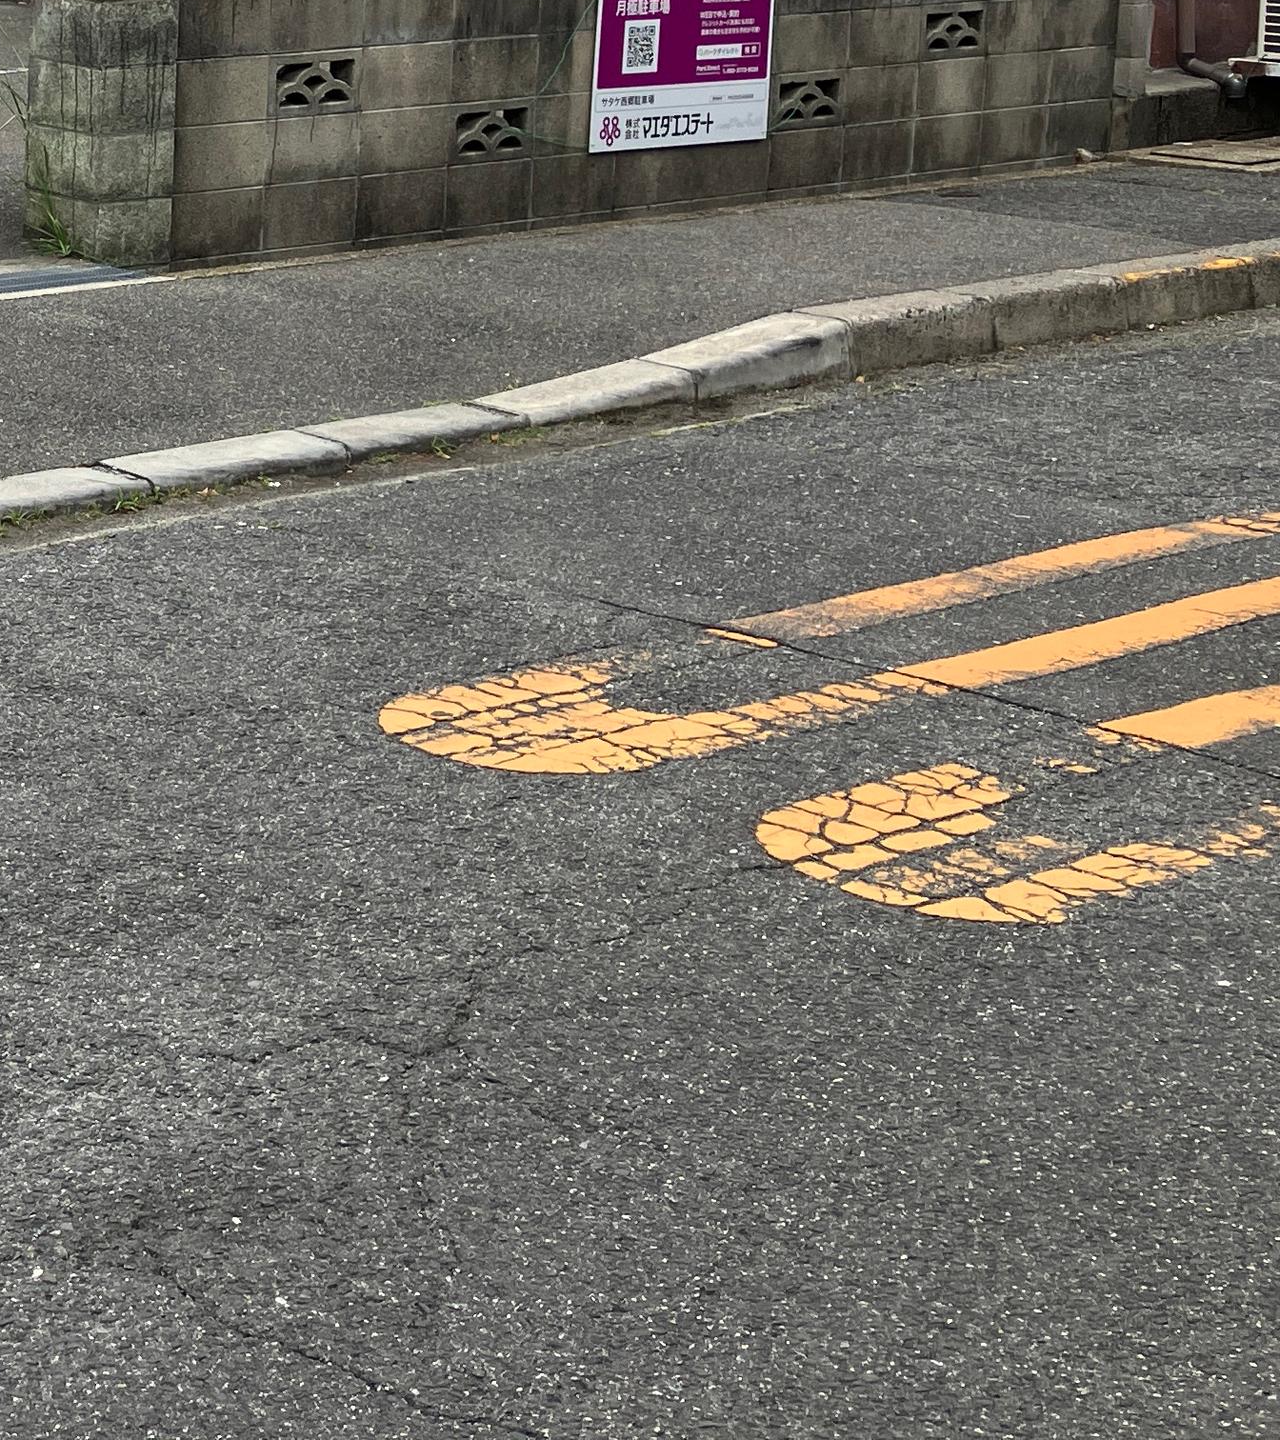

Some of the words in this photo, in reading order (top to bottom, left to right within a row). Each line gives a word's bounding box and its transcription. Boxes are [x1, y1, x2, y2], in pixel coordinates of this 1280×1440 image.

[642, 112, 714, 139] マエダエステート
